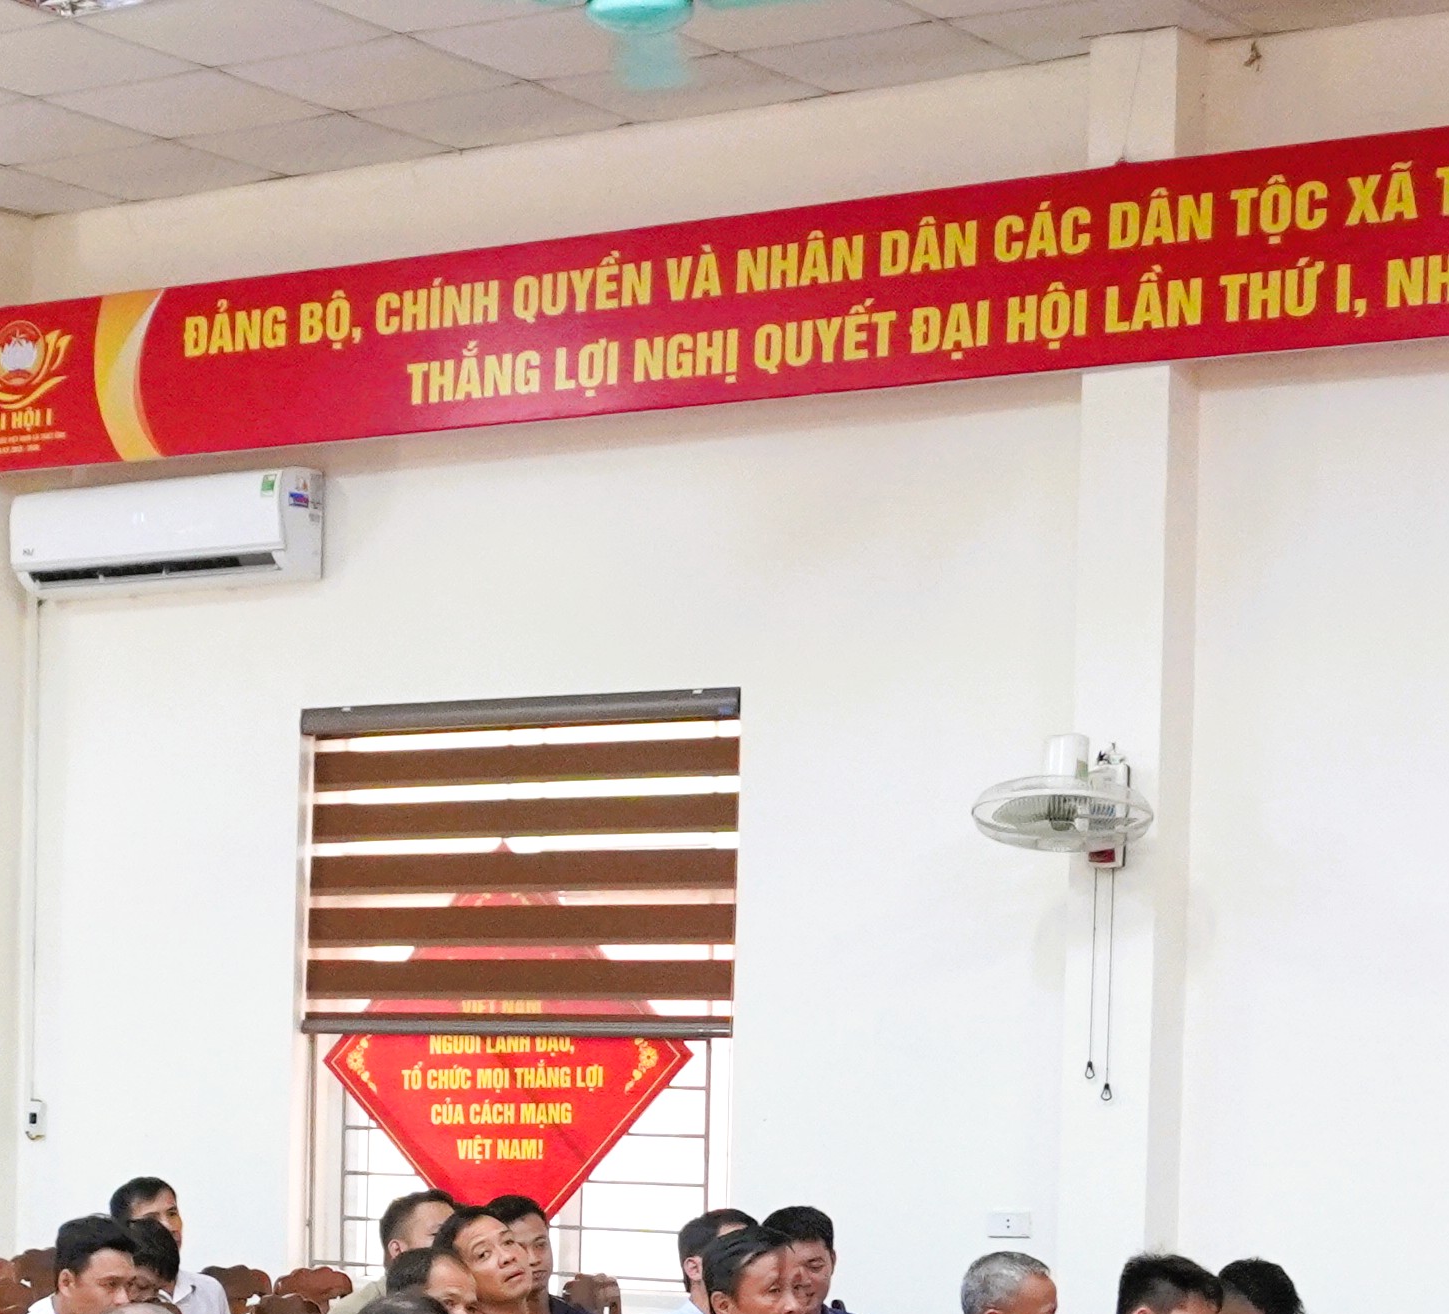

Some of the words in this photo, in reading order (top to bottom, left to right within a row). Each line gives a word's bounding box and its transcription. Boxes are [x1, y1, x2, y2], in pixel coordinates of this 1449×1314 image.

[183, 299, 287, 358] ĐẢNG
[299, 290, 362, 349] BỘ,
[376, 278, 500, 335] CHÍNH
[513, 251, 652, 323] QUYỀN
[666, 244, 721, 301] VÀ
[736, 230, 864, 293] NHÂN
[880, 216, 977, 276] DÂN
[994, 201, 1091, 262] CÁC
[1108, 188, 1213, 249] DÂN
[1230, 175, 1328, 244] TỘC
[1345, 161, 1418, 226] XÃ
[407, 341, 540, 405] THẮNG
[555, 338, 620, 392] LỢI
[633, 329, 738, 383] NGHỊ
[754, 298, 897, 374] QUYẾT
[909, 300, 990, 360] ĐẠI
[1006, 282, 1087, 349] HỘI
[1105, 265, 1202, 333] LẦN
[1220, 257, 1324, 322] THỨ
[1336, 264, 1367, 317] I,
[11, 406, 41, 432] HỘI
[46, 407, 53, 426] I
[402, 1061, 422, 1090] TỔ
[427, 1065, 471, 1090] CHỨC
[477, 1067, 509, 1093] MỌI
[515, 1060, 571, 1089] THẮNG
[576, 1065, 604, 1092] LỢI
[431, 1097, 465, 1124] CỦA
[469, 1100, 515, 1124] CÁCH
[520, 1103, 572, 1128] MẠNG
[457, 1135, 492, 1164] VIỆT
[497, 1138, 544, 1160] NAM!
